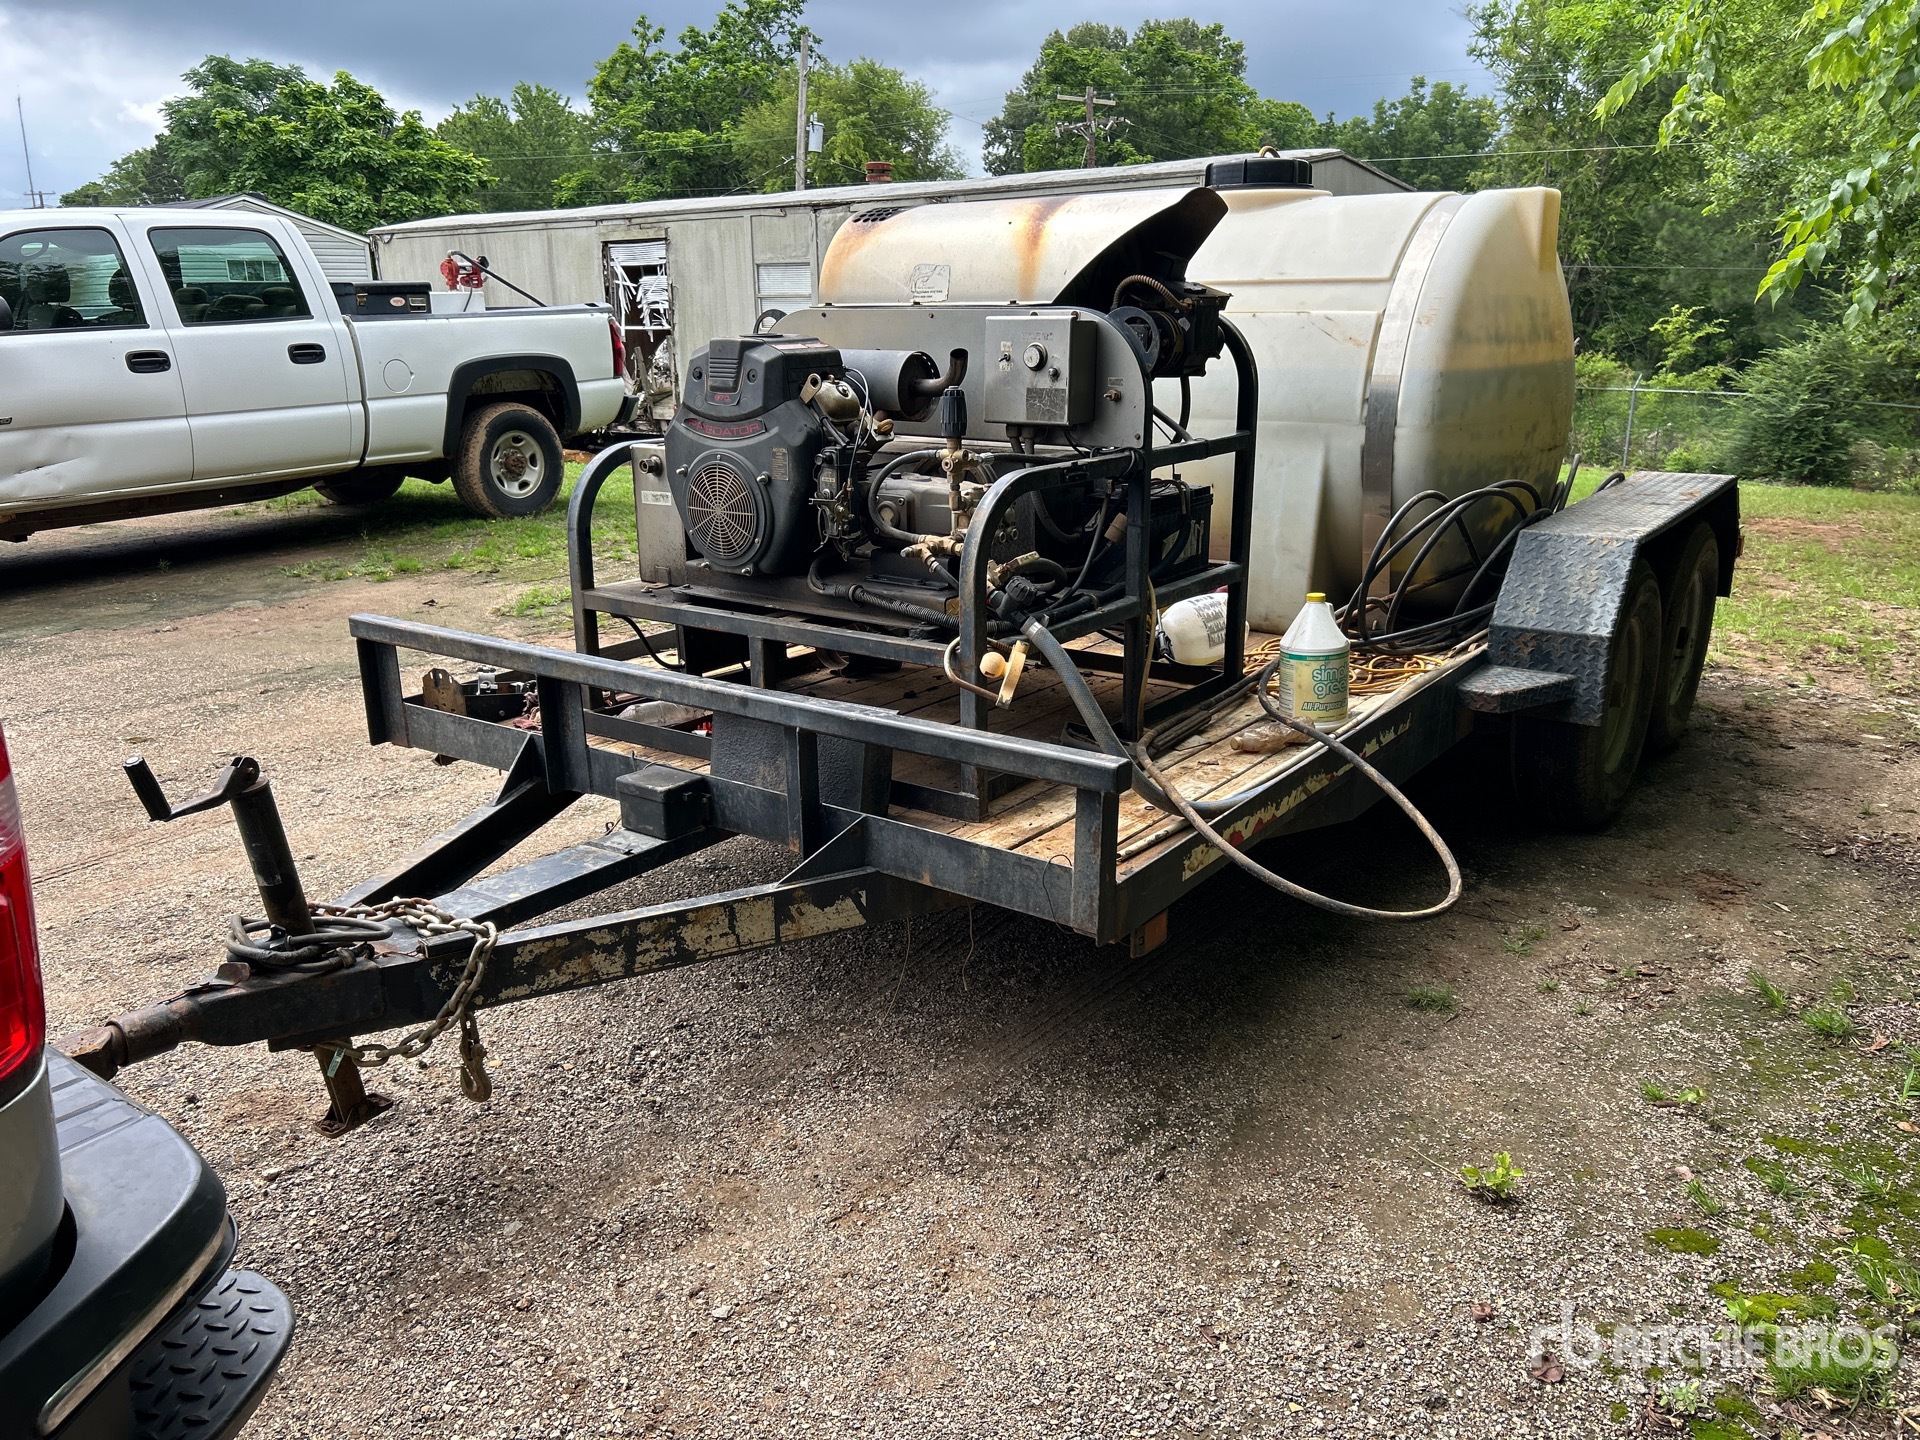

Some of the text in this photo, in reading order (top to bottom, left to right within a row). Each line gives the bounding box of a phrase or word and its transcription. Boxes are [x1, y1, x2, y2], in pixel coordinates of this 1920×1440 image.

[688, 419, 760, 436] PREDATOR
[1312, 662, 1348, 682] simpl
[1313, 681, 1348, 699] gree
